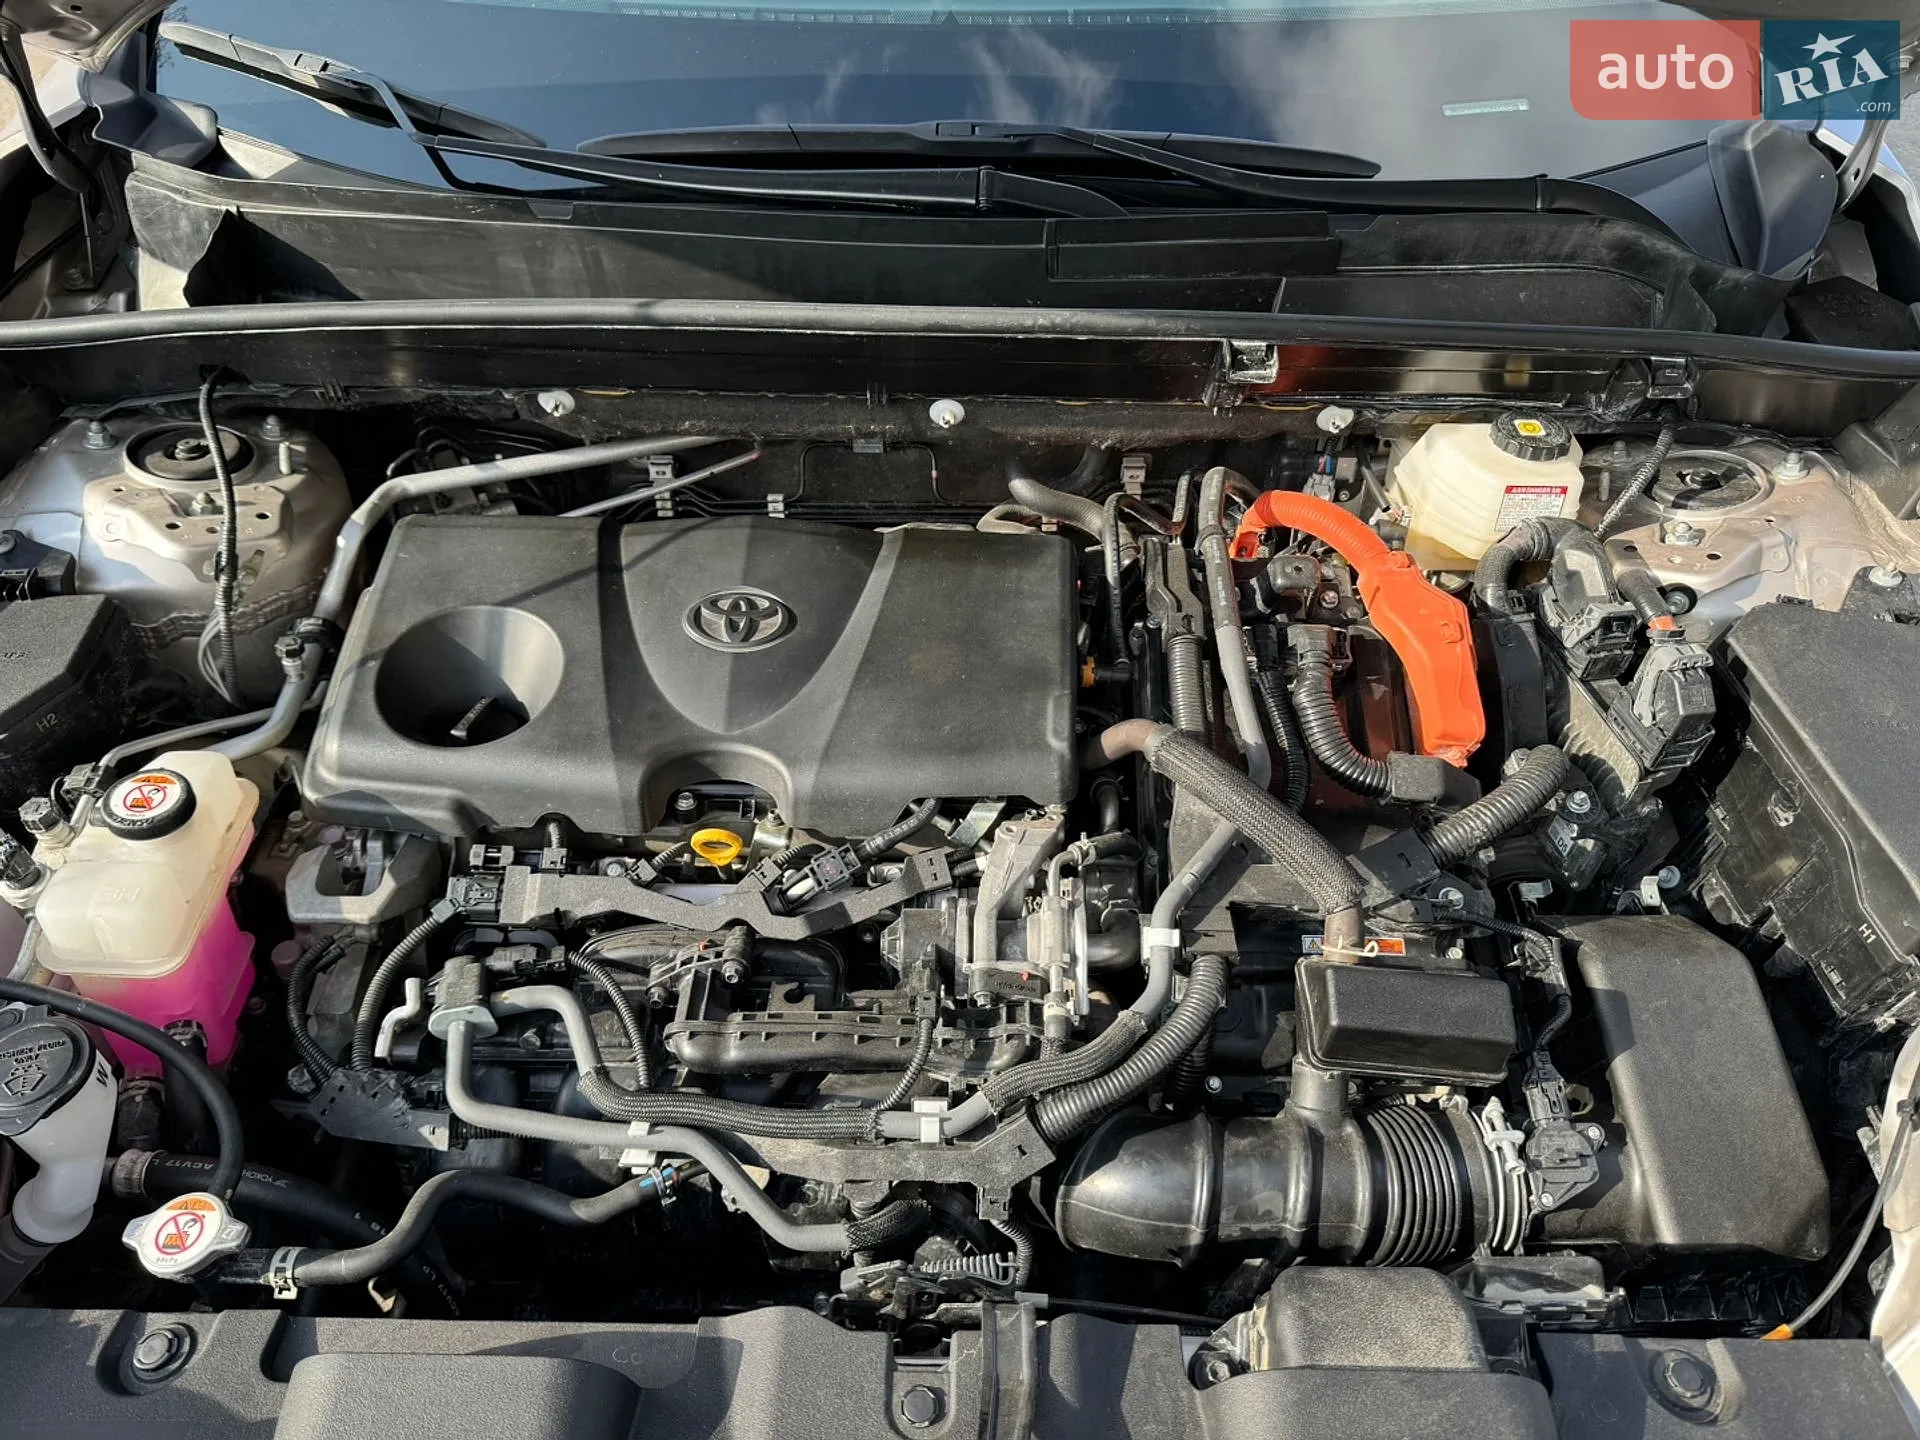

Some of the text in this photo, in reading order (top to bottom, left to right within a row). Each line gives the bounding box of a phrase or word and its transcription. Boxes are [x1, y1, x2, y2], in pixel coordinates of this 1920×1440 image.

[35, 712, 58, 733] H2
[1858, 923, 1876, 943] H1
[165, 1159, 214, 1170] ACV17
